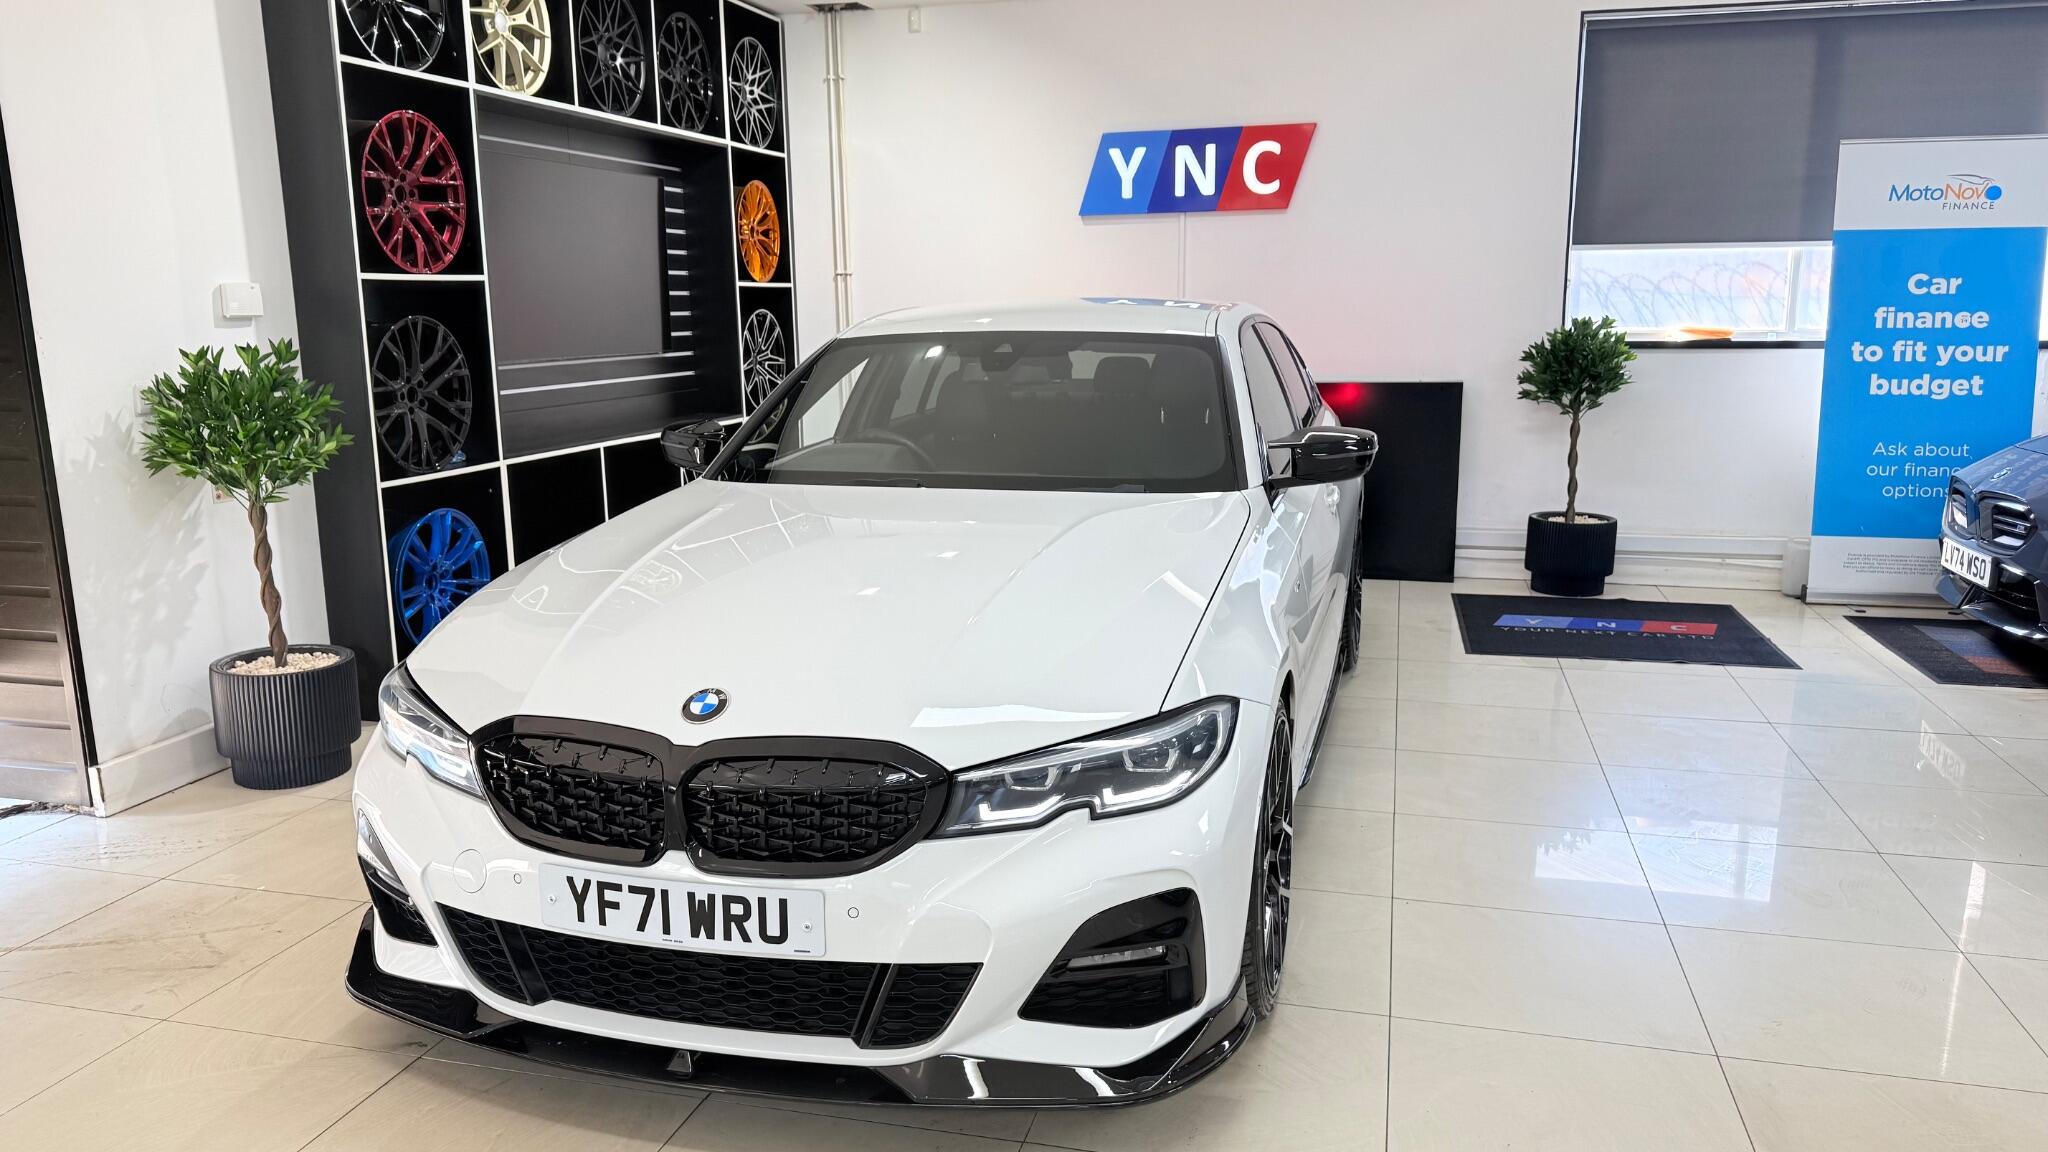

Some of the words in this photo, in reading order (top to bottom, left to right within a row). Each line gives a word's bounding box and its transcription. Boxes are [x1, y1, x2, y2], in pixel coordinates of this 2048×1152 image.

[1889, 183, 2003, 202] MotoNovo
[1942, 201, 1996, 210] FINANCE
[1907, 273, 1963, 295] Car
[1874, 306, 1990, 329] finance
[1851, 341, 1884, 362] to
[1892, 340, 1927, 362] fit
[1936, 344, 2009, 367] your
[1869, 373, 1984, 400] budget
[1872, 442, 1908, 456] Ask
[1914, 442, 1970, 457] about
[1866, 464, 1898, 476] our
[1904, 462, 1961, 477] financ
[1944, 542, 1965, 571] LV74
[1967, 552, 1987, 581] WSO
[566, 875, 671, 936] YF71
[687, 891, 789, 945] WRU
